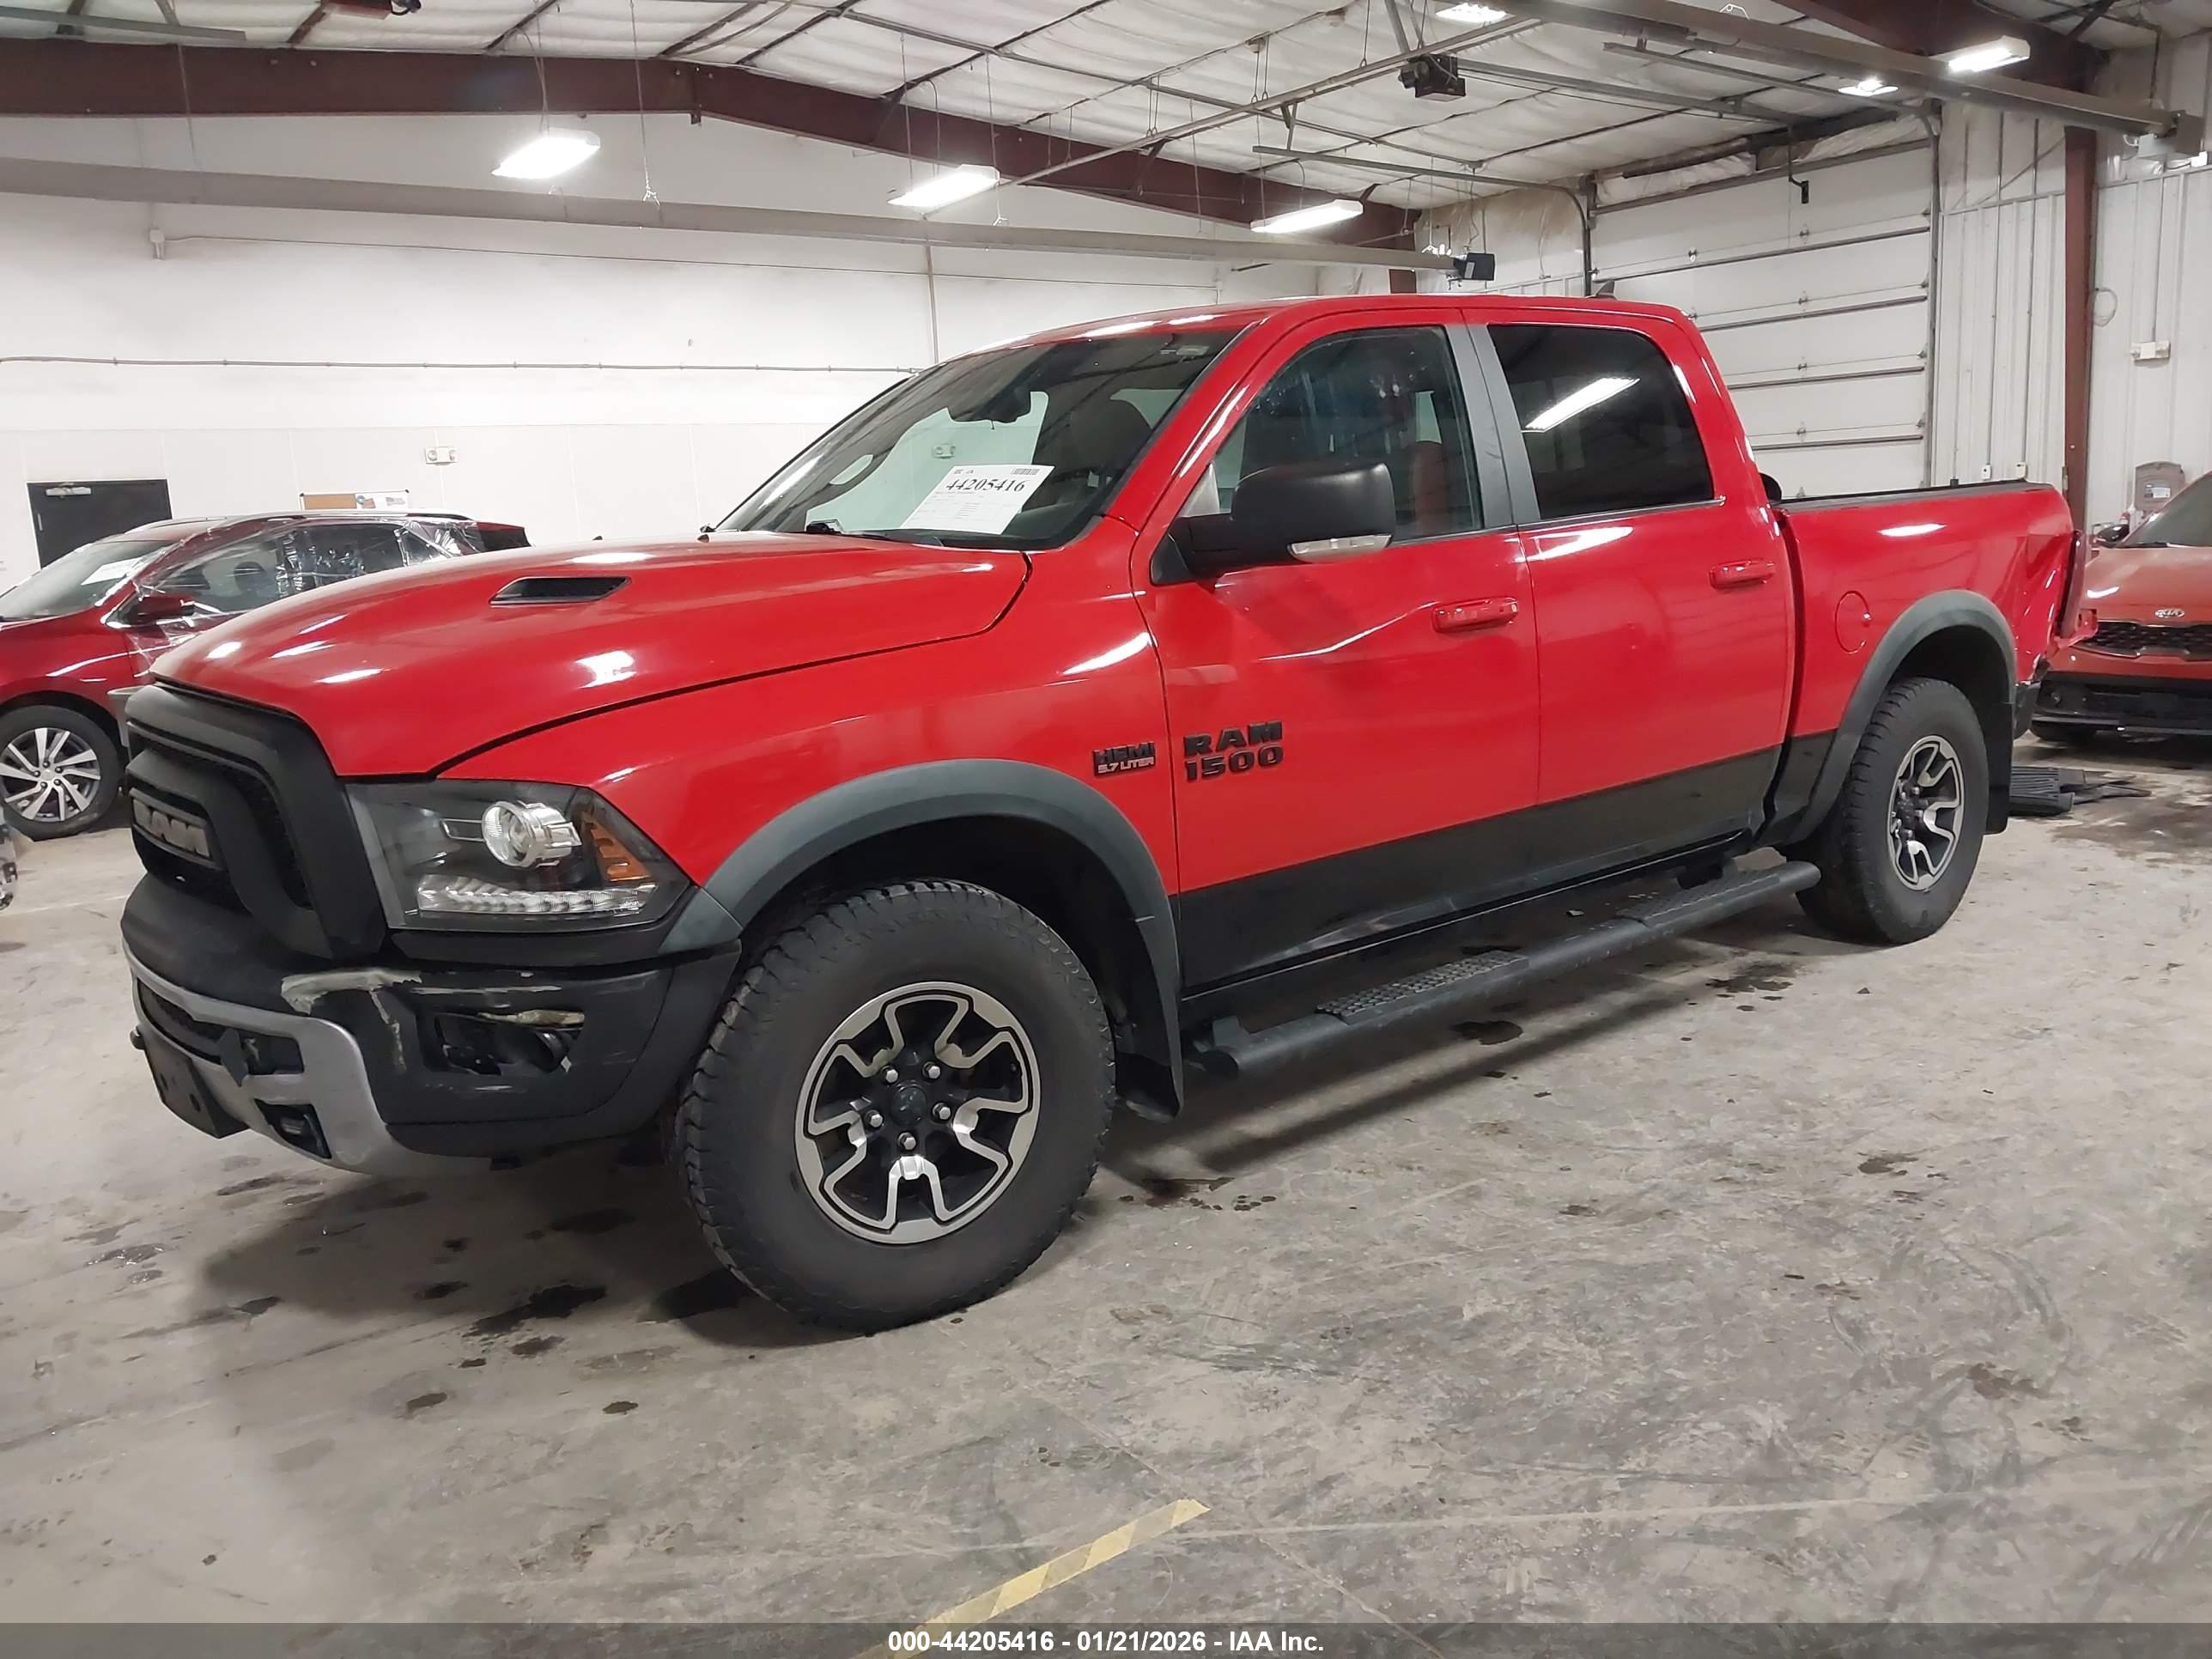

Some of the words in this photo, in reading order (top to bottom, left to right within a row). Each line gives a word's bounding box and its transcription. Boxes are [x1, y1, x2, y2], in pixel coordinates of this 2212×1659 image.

[945, 478, 1030, 492] 44205416
[1183, 720, 1283, 757] RAM
[1092, 742, 1156, 763] HEMI
[1185, 744, 1285, 782] 1500
[1097, 762, 1119, 774] 5.7
[1120, 757, 1155, 771] LITER
